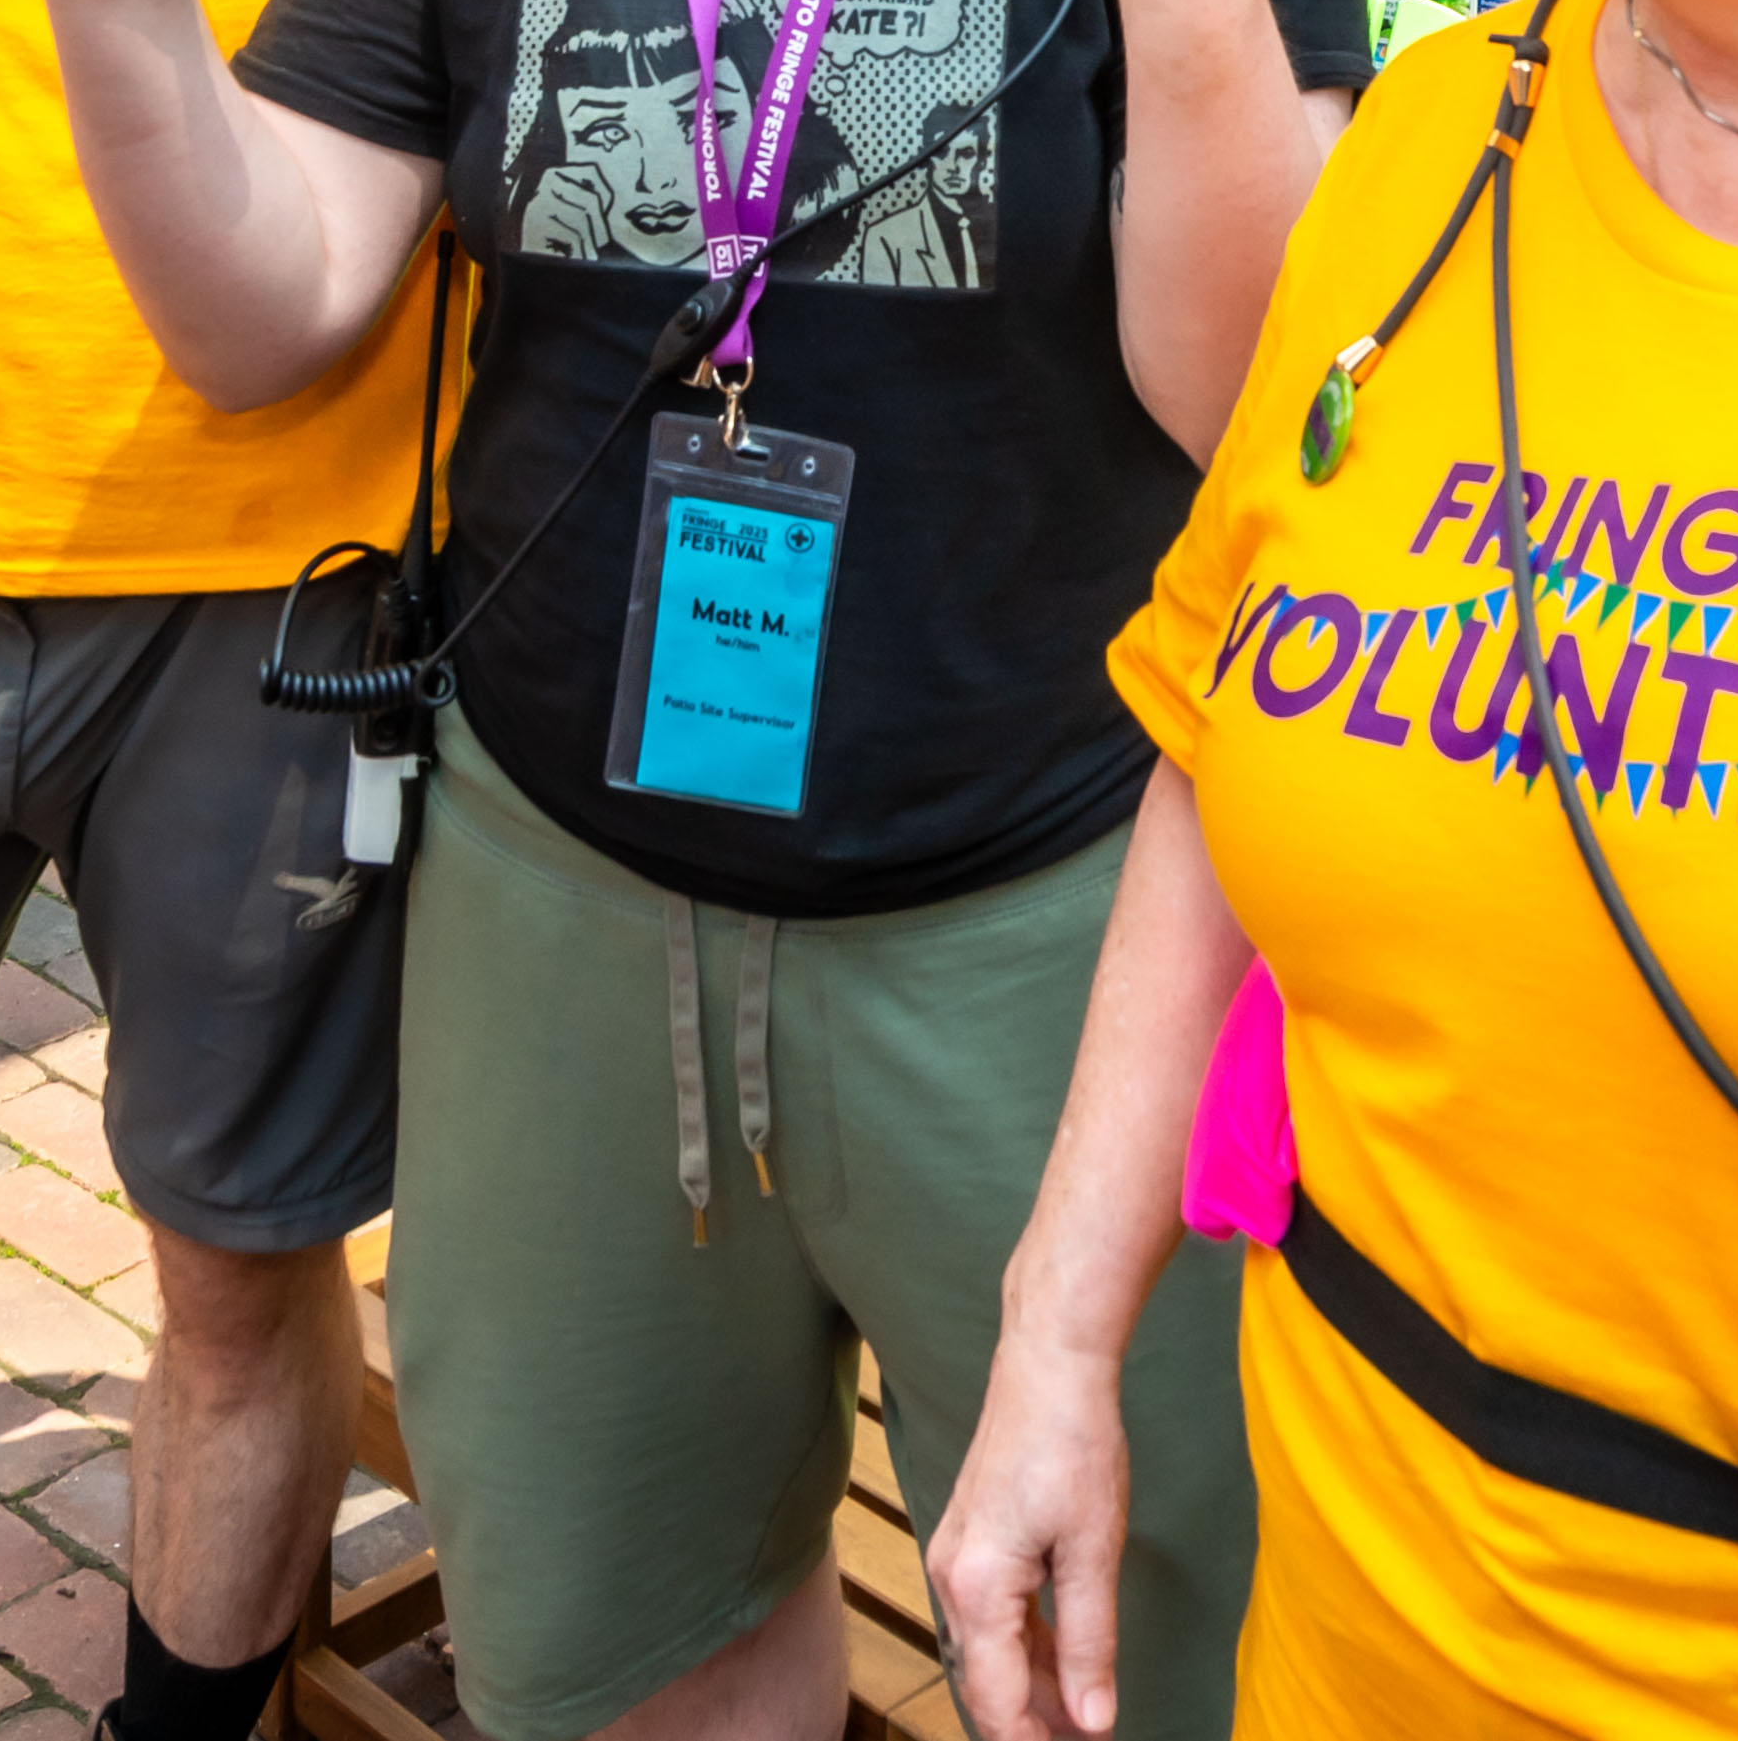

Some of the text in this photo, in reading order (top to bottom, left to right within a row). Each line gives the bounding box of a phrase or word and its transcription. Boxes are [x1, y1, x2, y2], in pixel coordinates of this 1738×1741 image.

[825, 9, 898, 36] KATE
[771, 29, 808, 105] FRINGE
[747, 105, 786, 201] FESTIVAL
[682, 513, 769, 540] FRINGE 2025
[679, 530, 766, 564] FESTIVAL
[692, 596, 790, 638] Matt M.
[715, 633, 761, 653] he/him
[663, 693, 796, 731] Patio Site Supervisor
